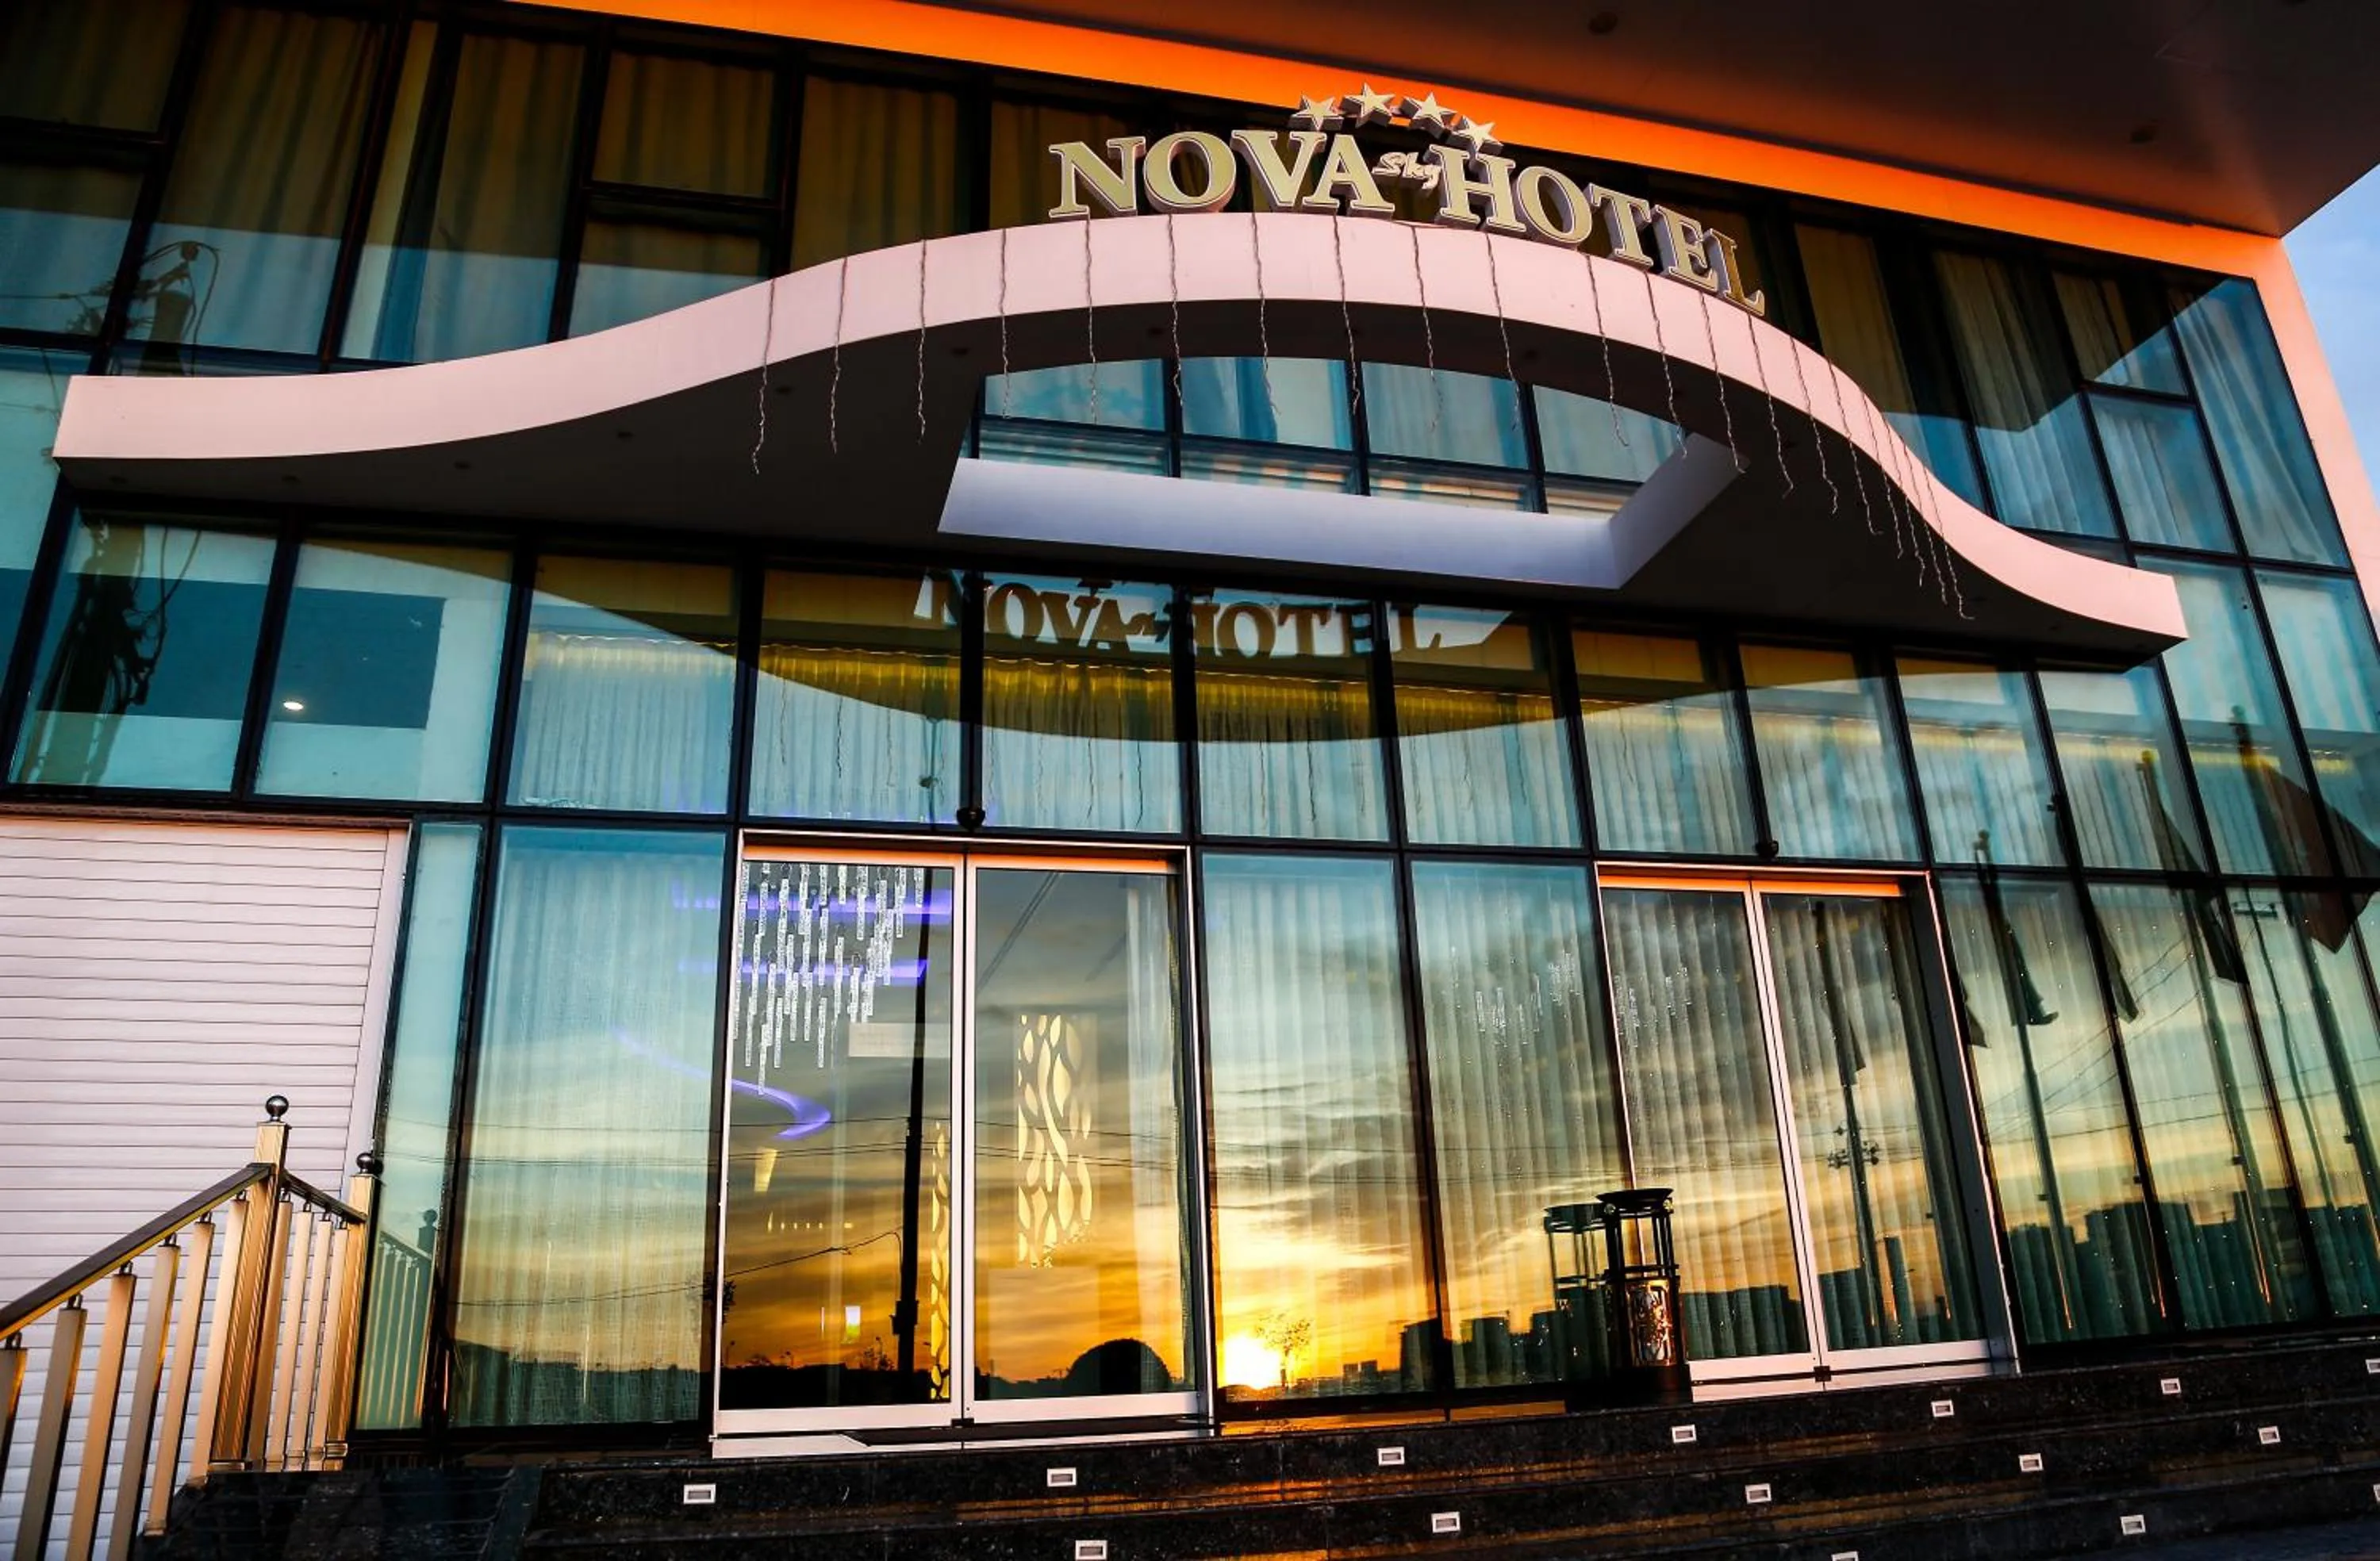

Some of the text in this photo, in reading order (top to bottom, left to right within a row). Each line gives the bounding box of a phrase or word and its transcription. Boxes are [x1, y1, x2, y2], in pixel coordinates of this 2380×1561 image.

[1048, 129, 1766, 316] NOVA Sky HOTEL
